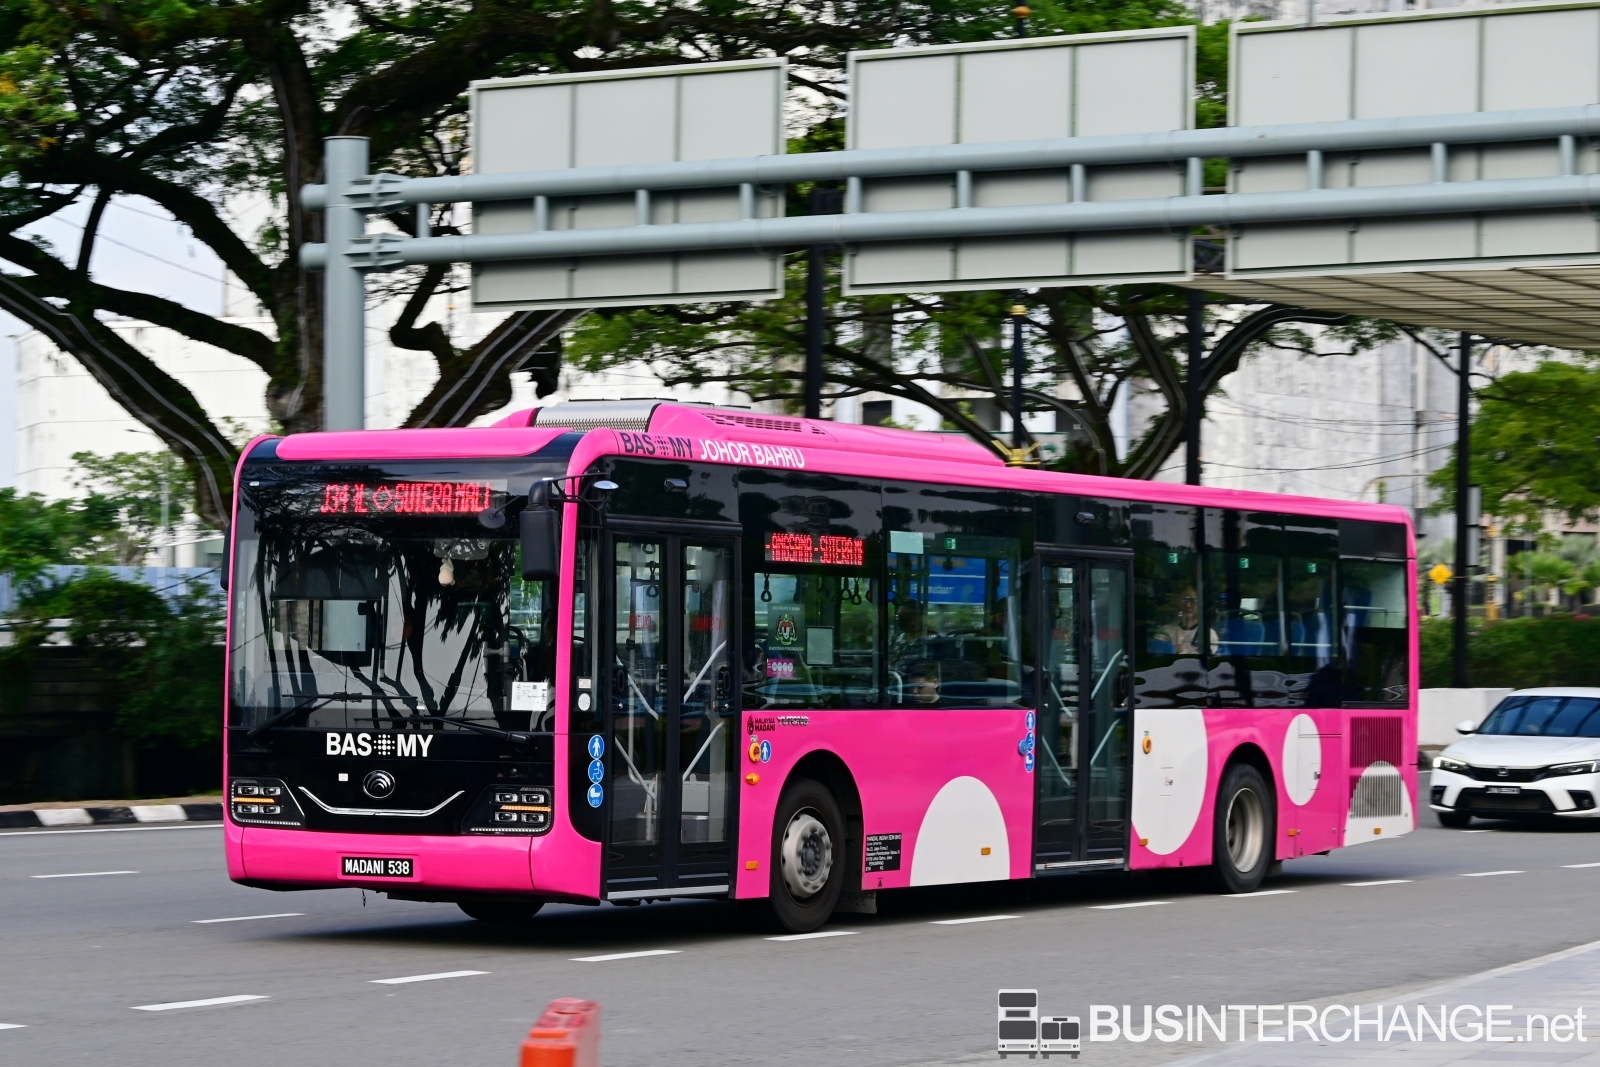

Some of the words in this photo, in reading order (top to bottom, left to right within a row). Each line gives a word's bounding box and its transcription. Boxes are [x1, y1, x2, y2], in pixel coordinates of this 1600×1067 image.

[619, 432, 656, 455] BAS
[667, 436, 693, 458] MY
[699, 439, 752, 463] JOHOR
[750, 444, 805, 468] BAHRU
[394, 482, 452, 512] SUTERA
[755, 723, 776, 731] MADANI
[326, 732, 372, 756] BAS
[397, 733, 434, 757] MY
[345, 859, 384, 874] MADANI
[388, 861, 409, 874] 538
